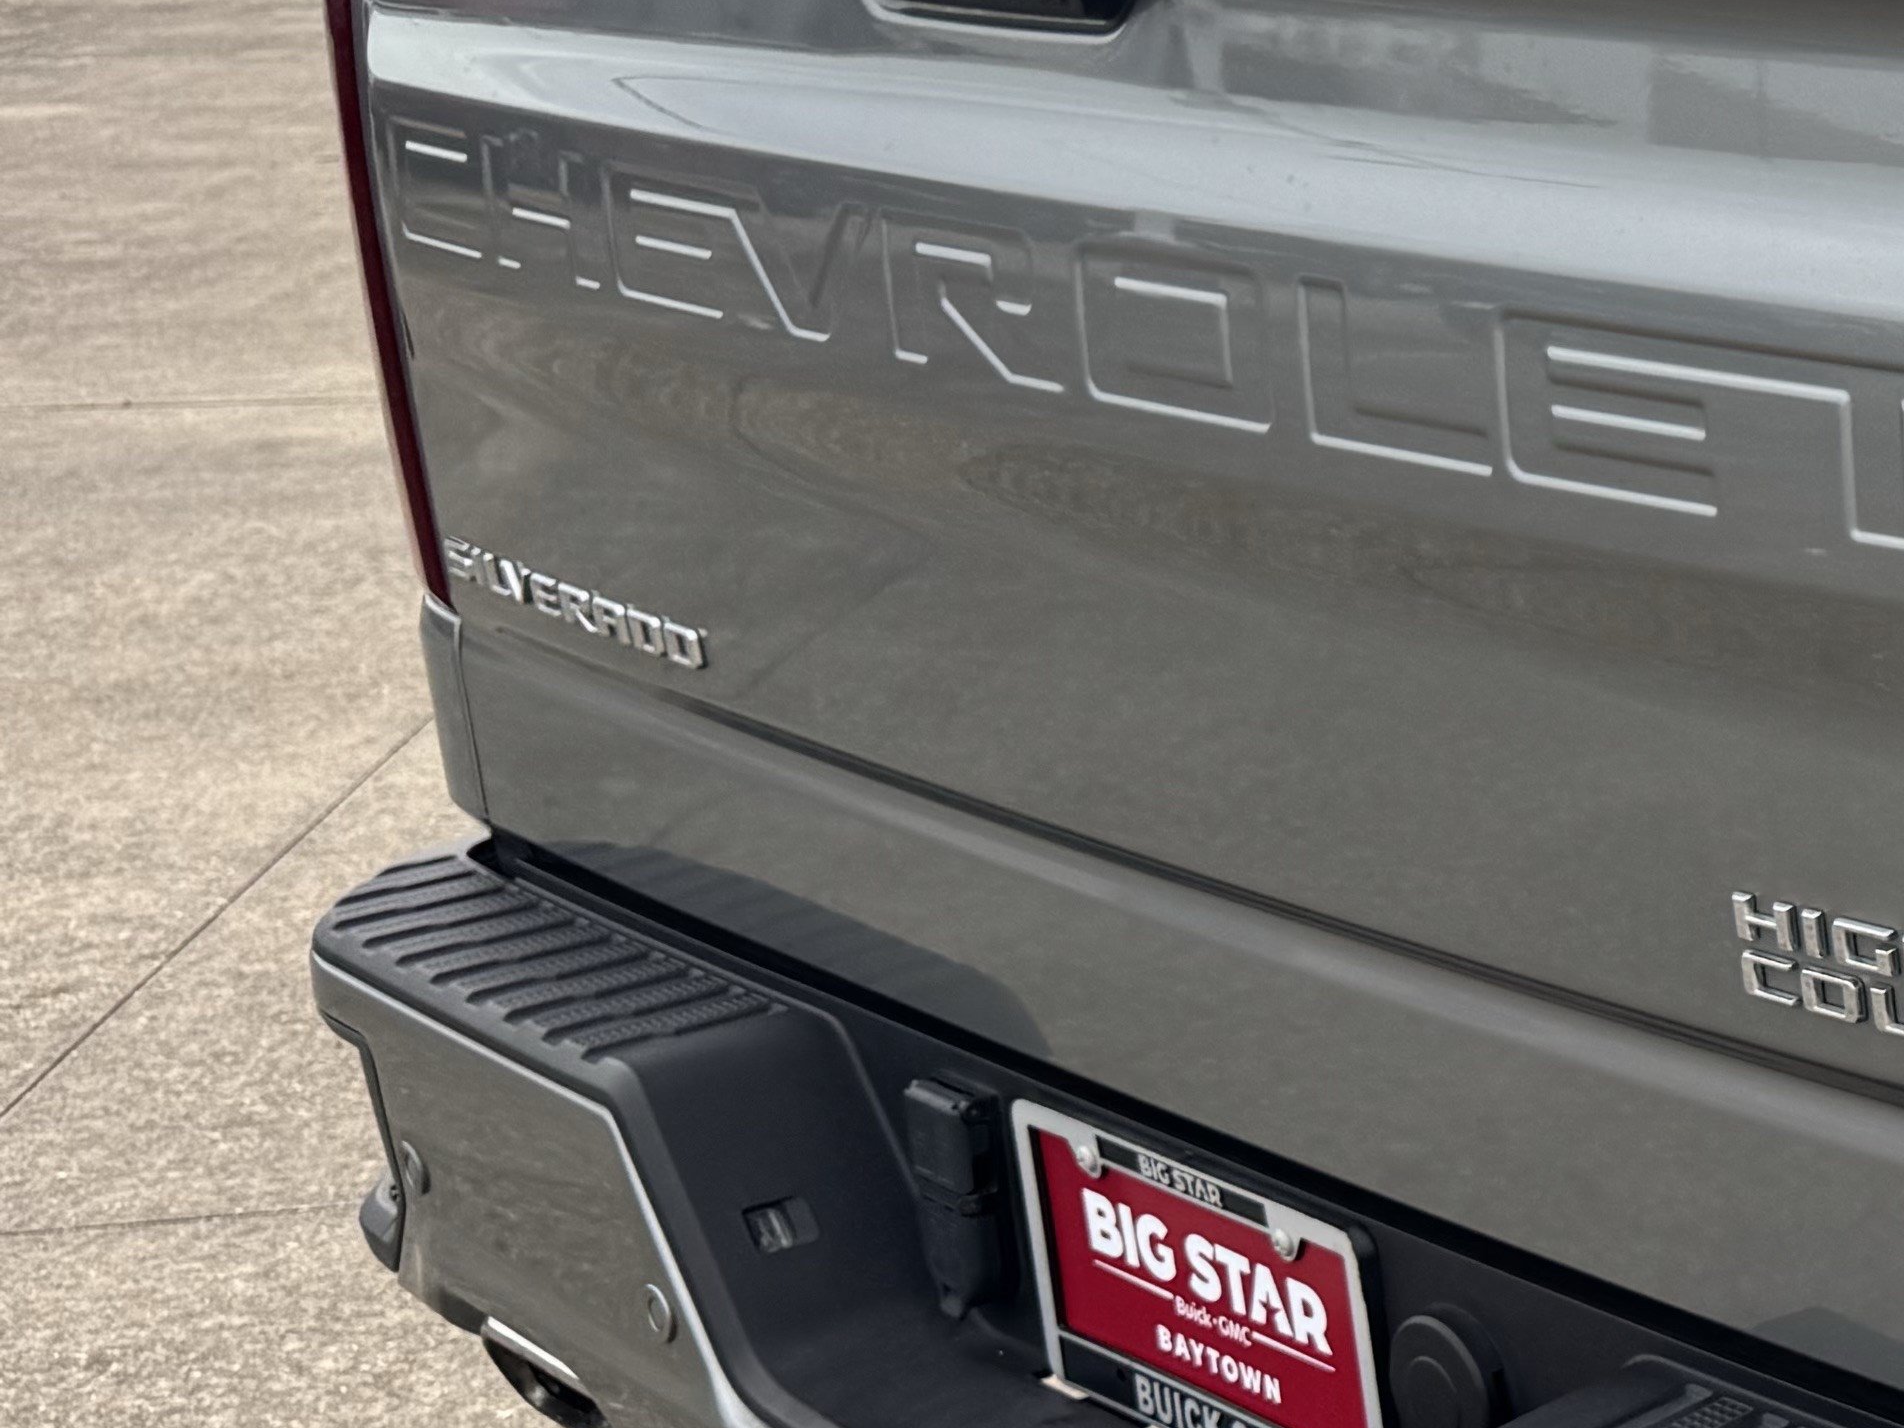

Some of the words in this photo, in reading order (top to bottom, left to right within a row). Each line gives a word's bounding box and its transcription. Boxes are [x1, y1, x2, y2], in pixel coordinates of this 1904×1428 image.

[445, 535, 707, 669] SILVERADO
[1137, 1153, 1169, 1187] BIG
[1173, 1172, 1223, 1208] STAR
[1082, 1187, 1177, 1282] BIG
[1184, 1232, 1334, 1357] STAR
[1155, 1324, 1282, 1404] BAYTOWN
